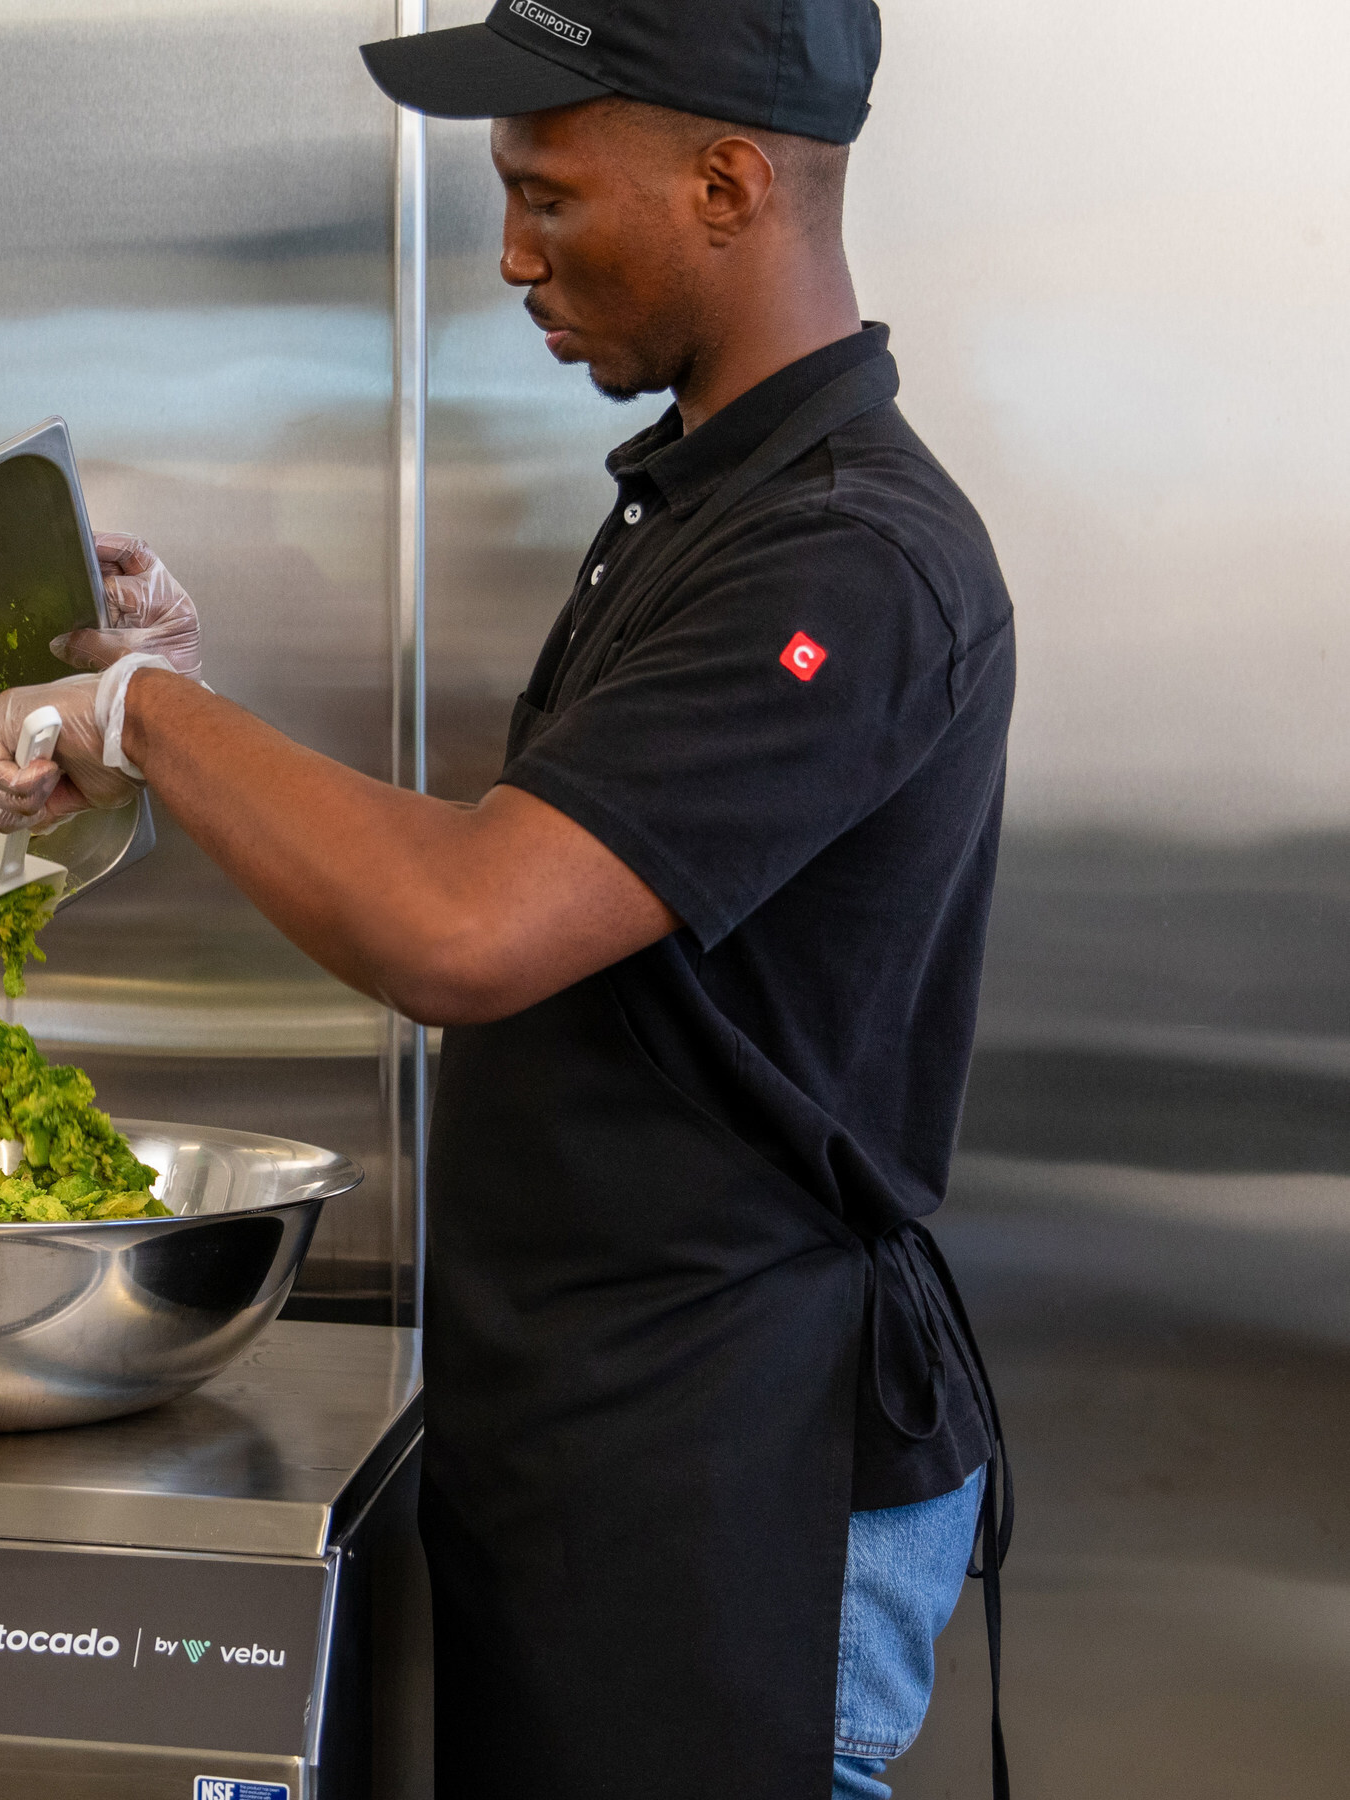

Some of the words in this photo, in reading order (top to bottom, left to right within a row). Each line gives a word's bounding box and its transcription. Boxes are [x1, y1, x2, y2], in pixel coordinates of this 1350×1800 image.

[527, 7, 586, 41] CHIPOTLE
[793, 645, 814, 669] C
[154, 1637, 179, 1655] by
[220, 1643, 285, 1666] vebu
[201, 1780, 235, 1800] NSF
